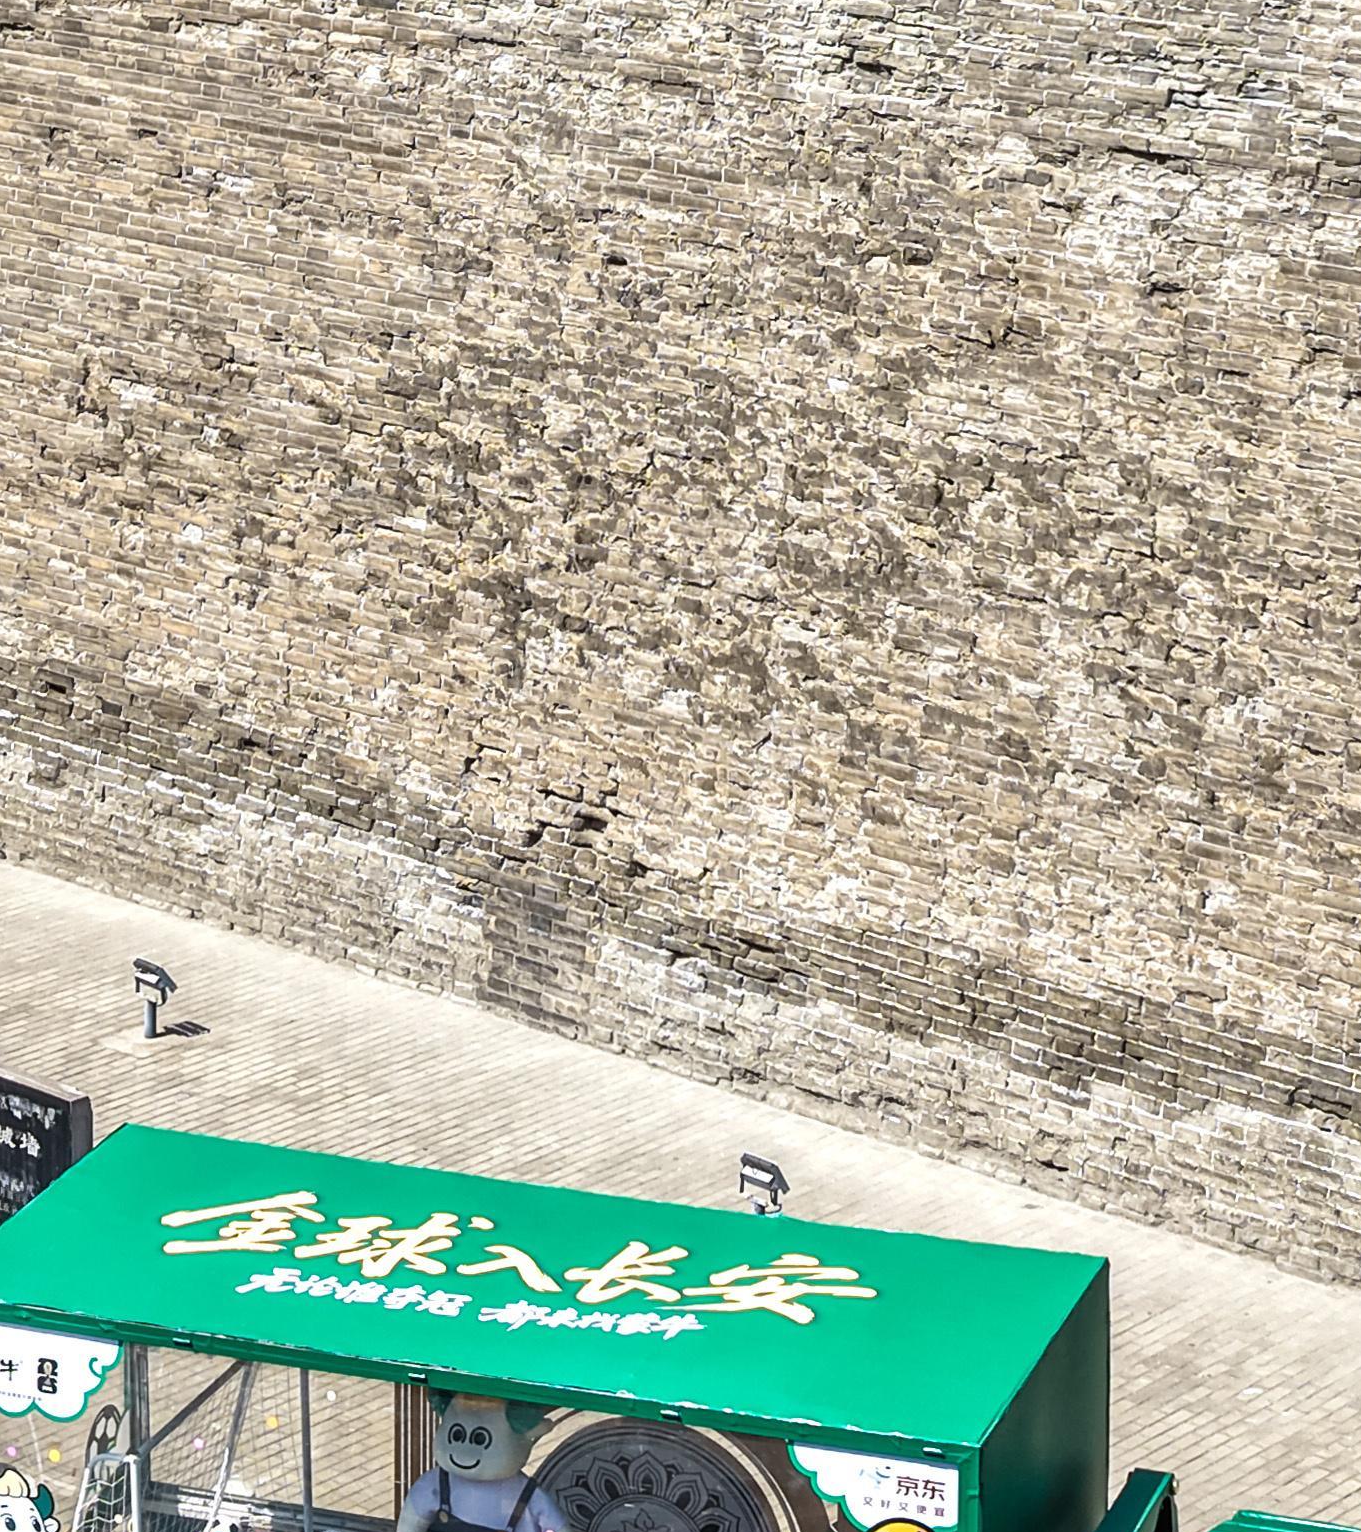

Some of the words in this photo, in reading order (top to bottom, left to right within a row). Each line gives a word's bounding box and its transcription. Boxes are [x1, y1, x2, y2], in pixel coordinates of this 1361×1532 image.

[160, 1190, 879, 1324] 全球入长安
[896, 1475, 947, 1502] 京东
